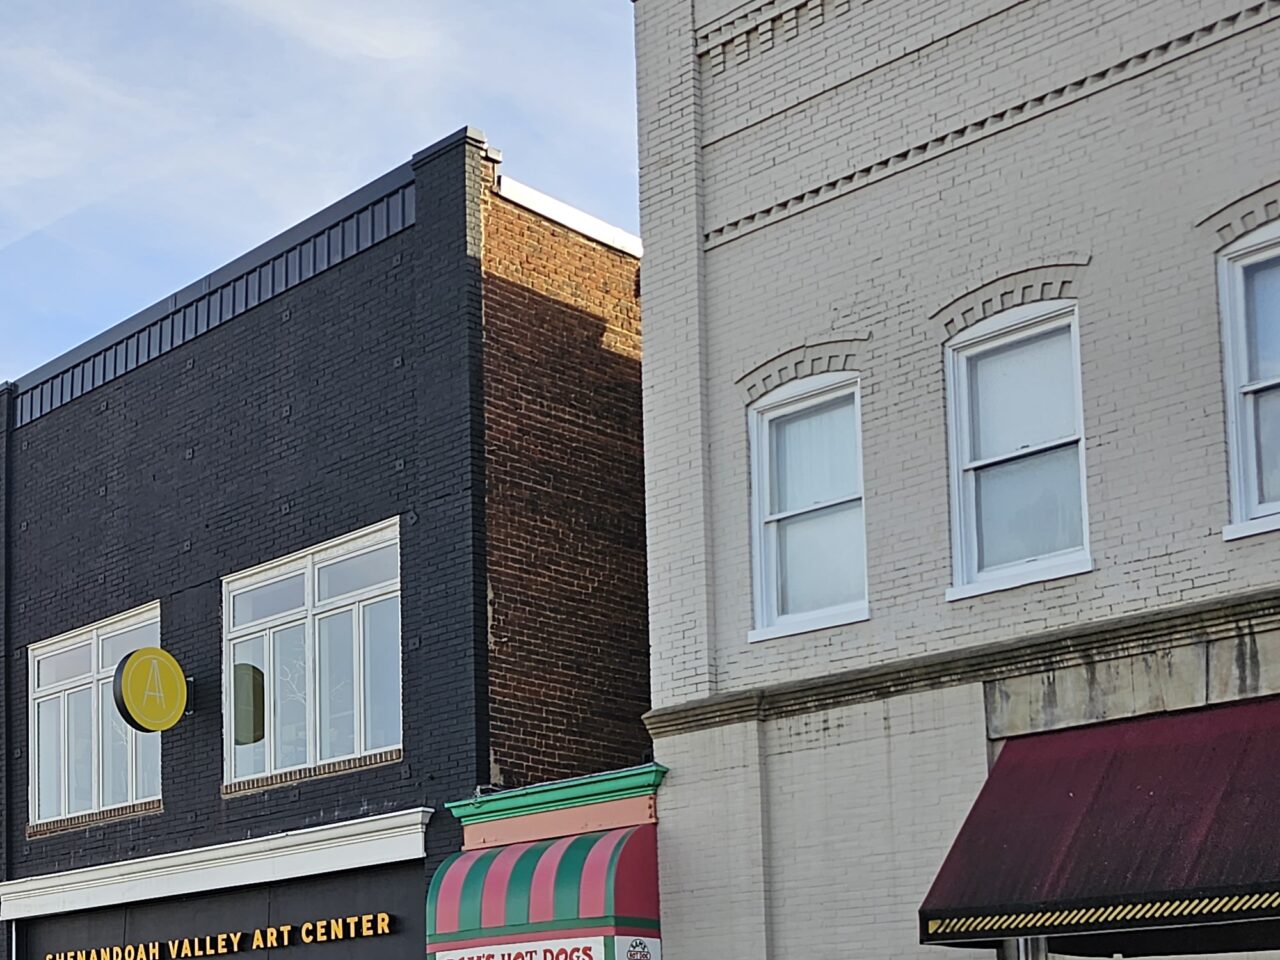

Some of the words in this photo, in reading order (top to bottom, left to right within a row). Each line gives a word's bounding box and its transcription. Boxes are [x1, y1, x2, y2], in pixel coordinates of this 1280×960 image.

[142, 659, 166, 709] A
[168, 931, 242, 959] VALLEY
[252, 925, 292, 950] ART
[301, 912, 391, 944] CENTER
